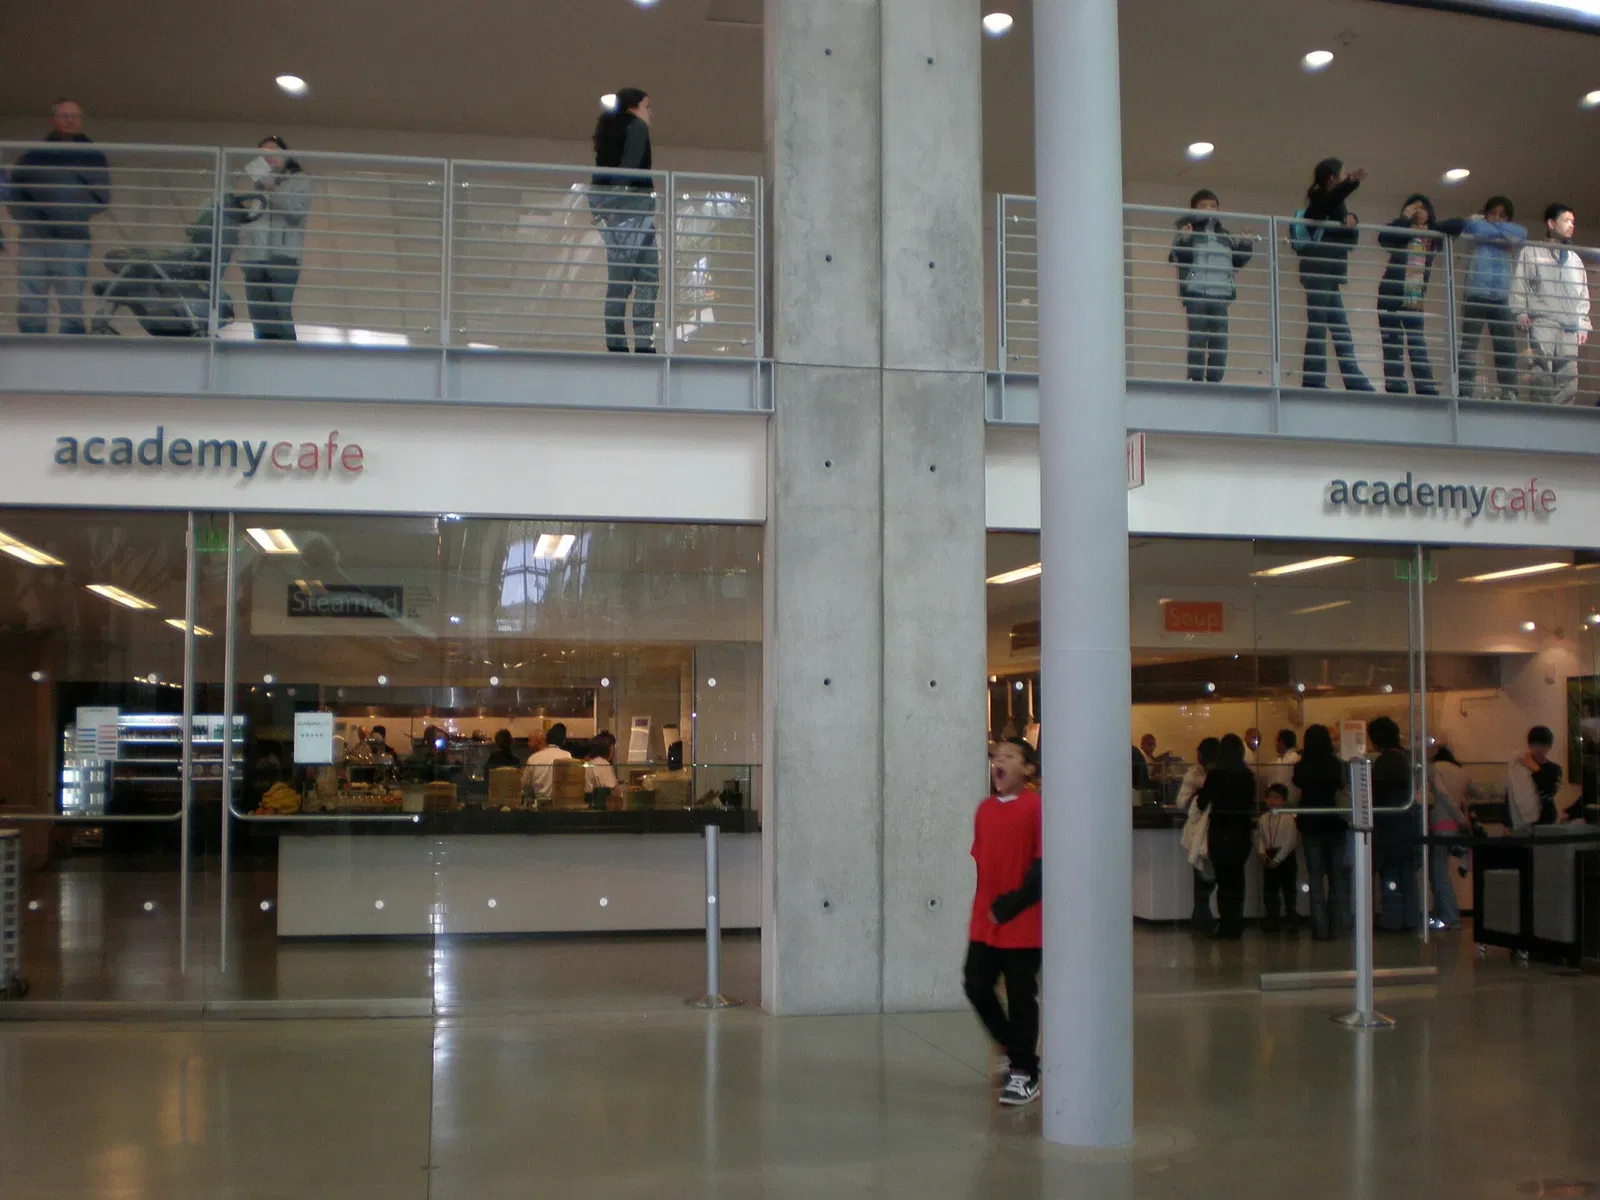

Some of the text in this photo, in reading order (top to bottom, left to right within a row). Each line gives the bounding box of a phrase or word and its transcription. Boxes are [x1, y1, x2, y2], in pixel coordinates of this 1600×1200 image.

[54, 425, 364, 477] academycafe
[1330, 471, 1557, 517] academycafe
[291, 590, 398, 614] Steamed
[1170, 607, 1219, 632] Soup
